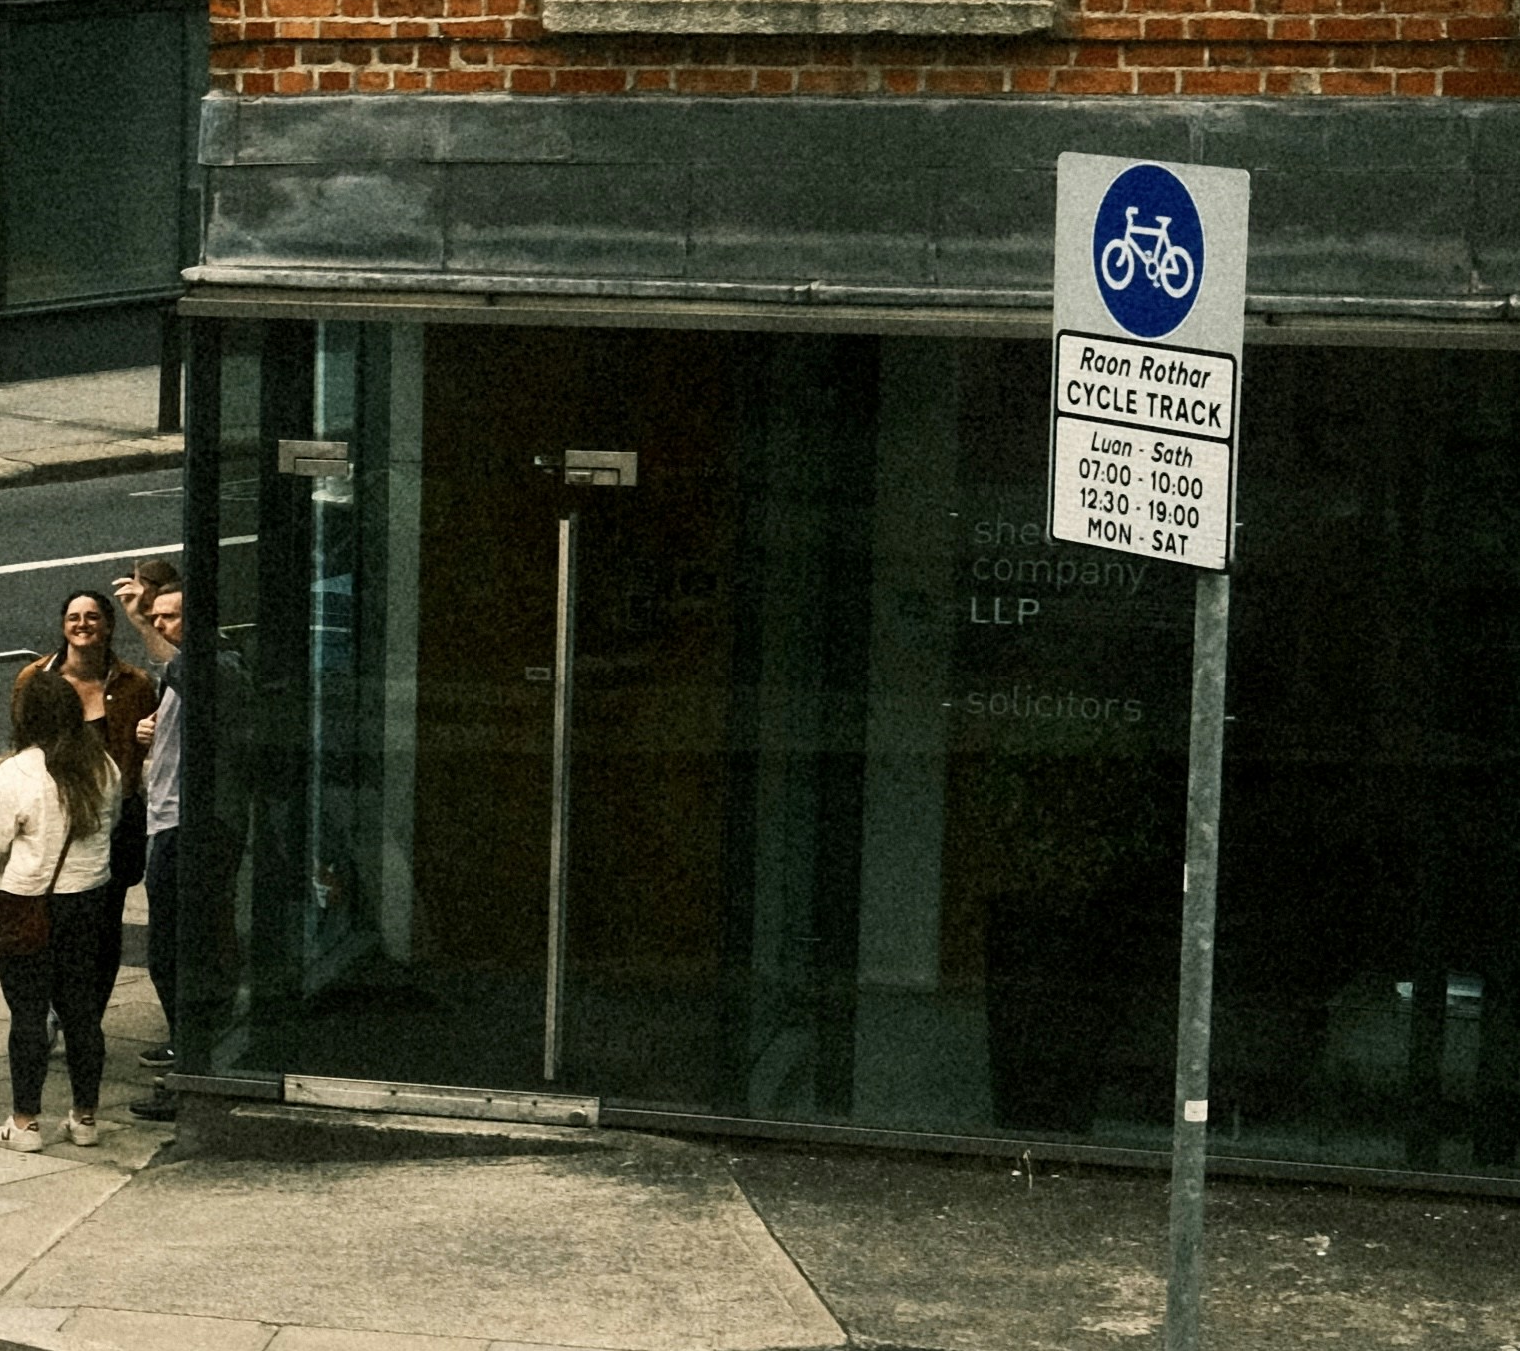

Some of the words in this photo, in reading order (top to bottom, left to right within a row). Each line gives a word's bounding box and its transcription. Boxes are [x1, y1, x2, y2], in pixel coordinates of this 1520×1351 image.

[1079, 346, 1132, 377] Raon
[1138, 355, 1212, 389] Rothar
[1067, 380, 1138, 415] CYCLE
[1146, 392, 1223, 429] TRACK
[1090, 431, 1133, 457] Luan
[1151, 441, 1194, 468] Sath
[1078, 457, 1132, 487] 07:00
[1151, 470, 1204, 500] 10:00
[1079, 487, 1129, 516] 12:30
[1148, 500, 1200, 529] 19:00
[1087, 517, 1132, 546] MON
[1151, 529, 1189, 557] SAT
[971, 556, 1148, 596] company
[969, 594, 1042, 627] LLP
[965, 683, 1145, 723] solicitors
